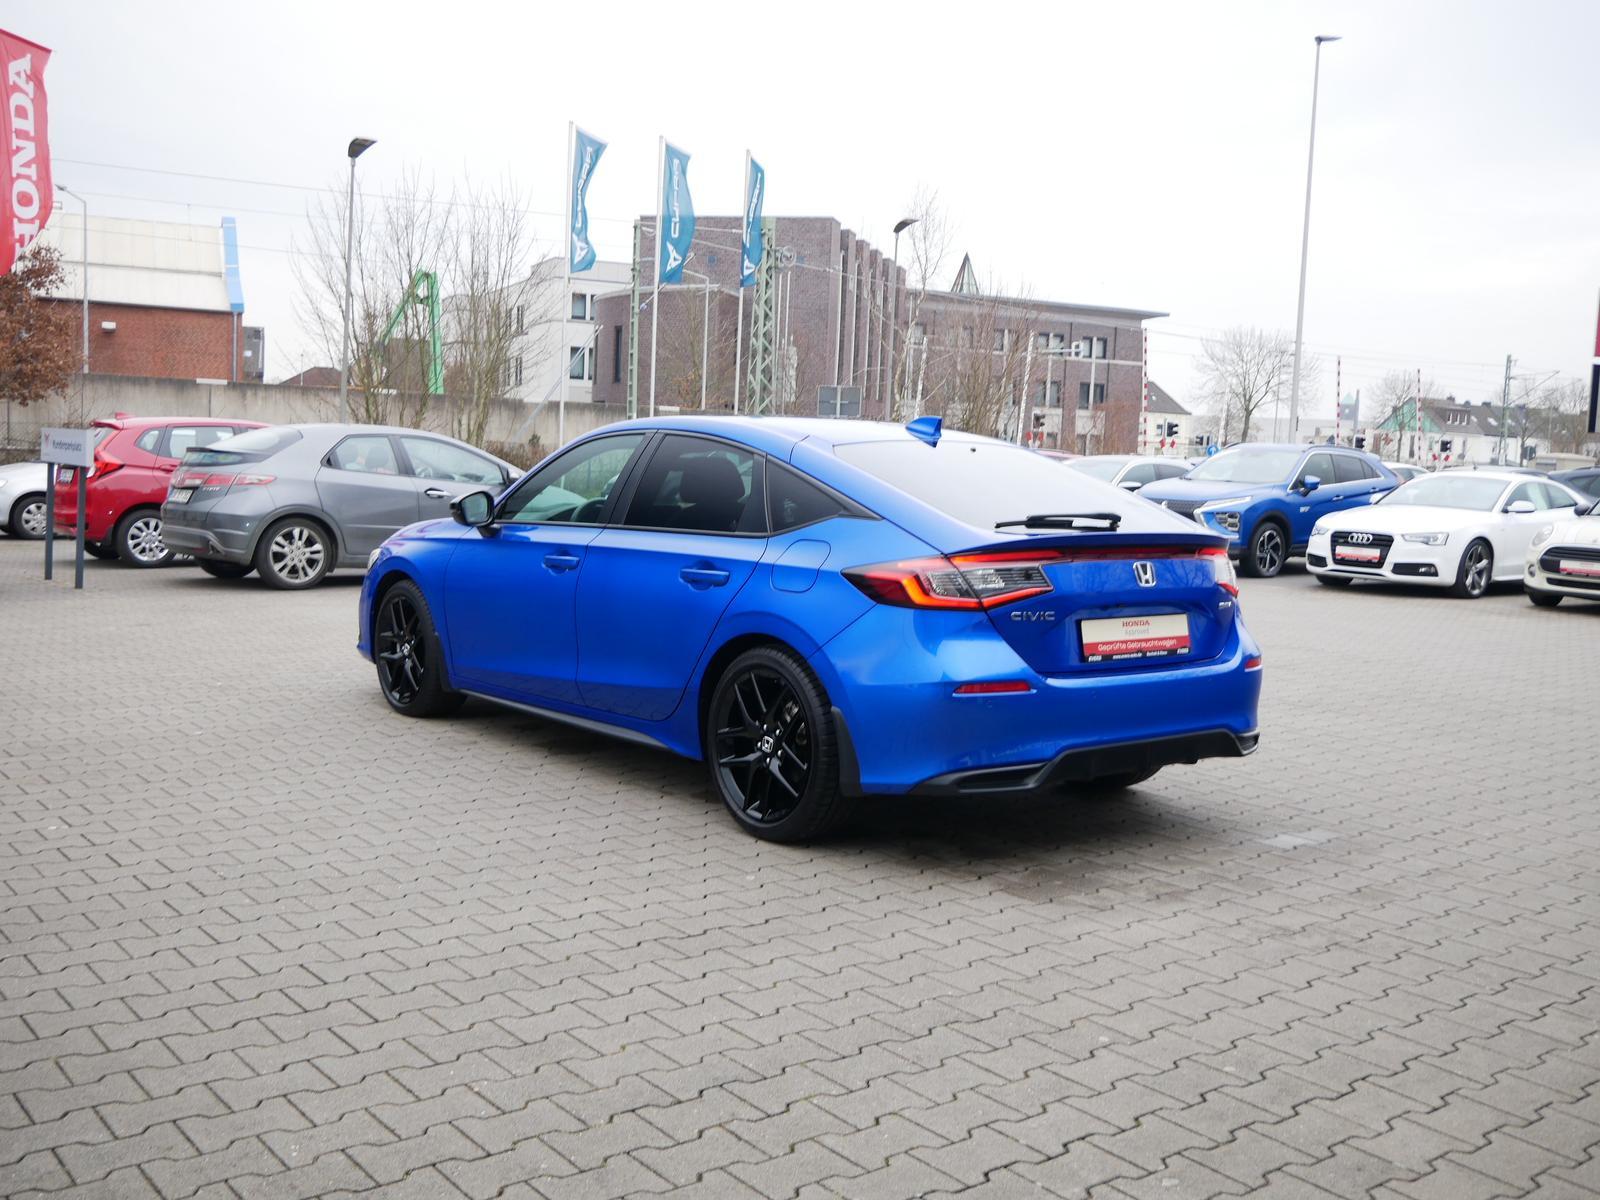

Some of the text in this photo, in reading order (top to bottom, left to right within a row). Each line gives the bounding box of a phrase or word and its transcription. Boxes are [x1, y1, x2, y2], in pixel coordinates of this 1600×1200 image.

[8, 53, 40, 263] HONDA
[670, 158, 680, 239] CUPRA
[1010, 610, 1056, 622] CIVIC
[1121, 619, 1151, 628] HONDA
[1097, 638, 1177, 652] Geprüfte Gebrauchtwagen
